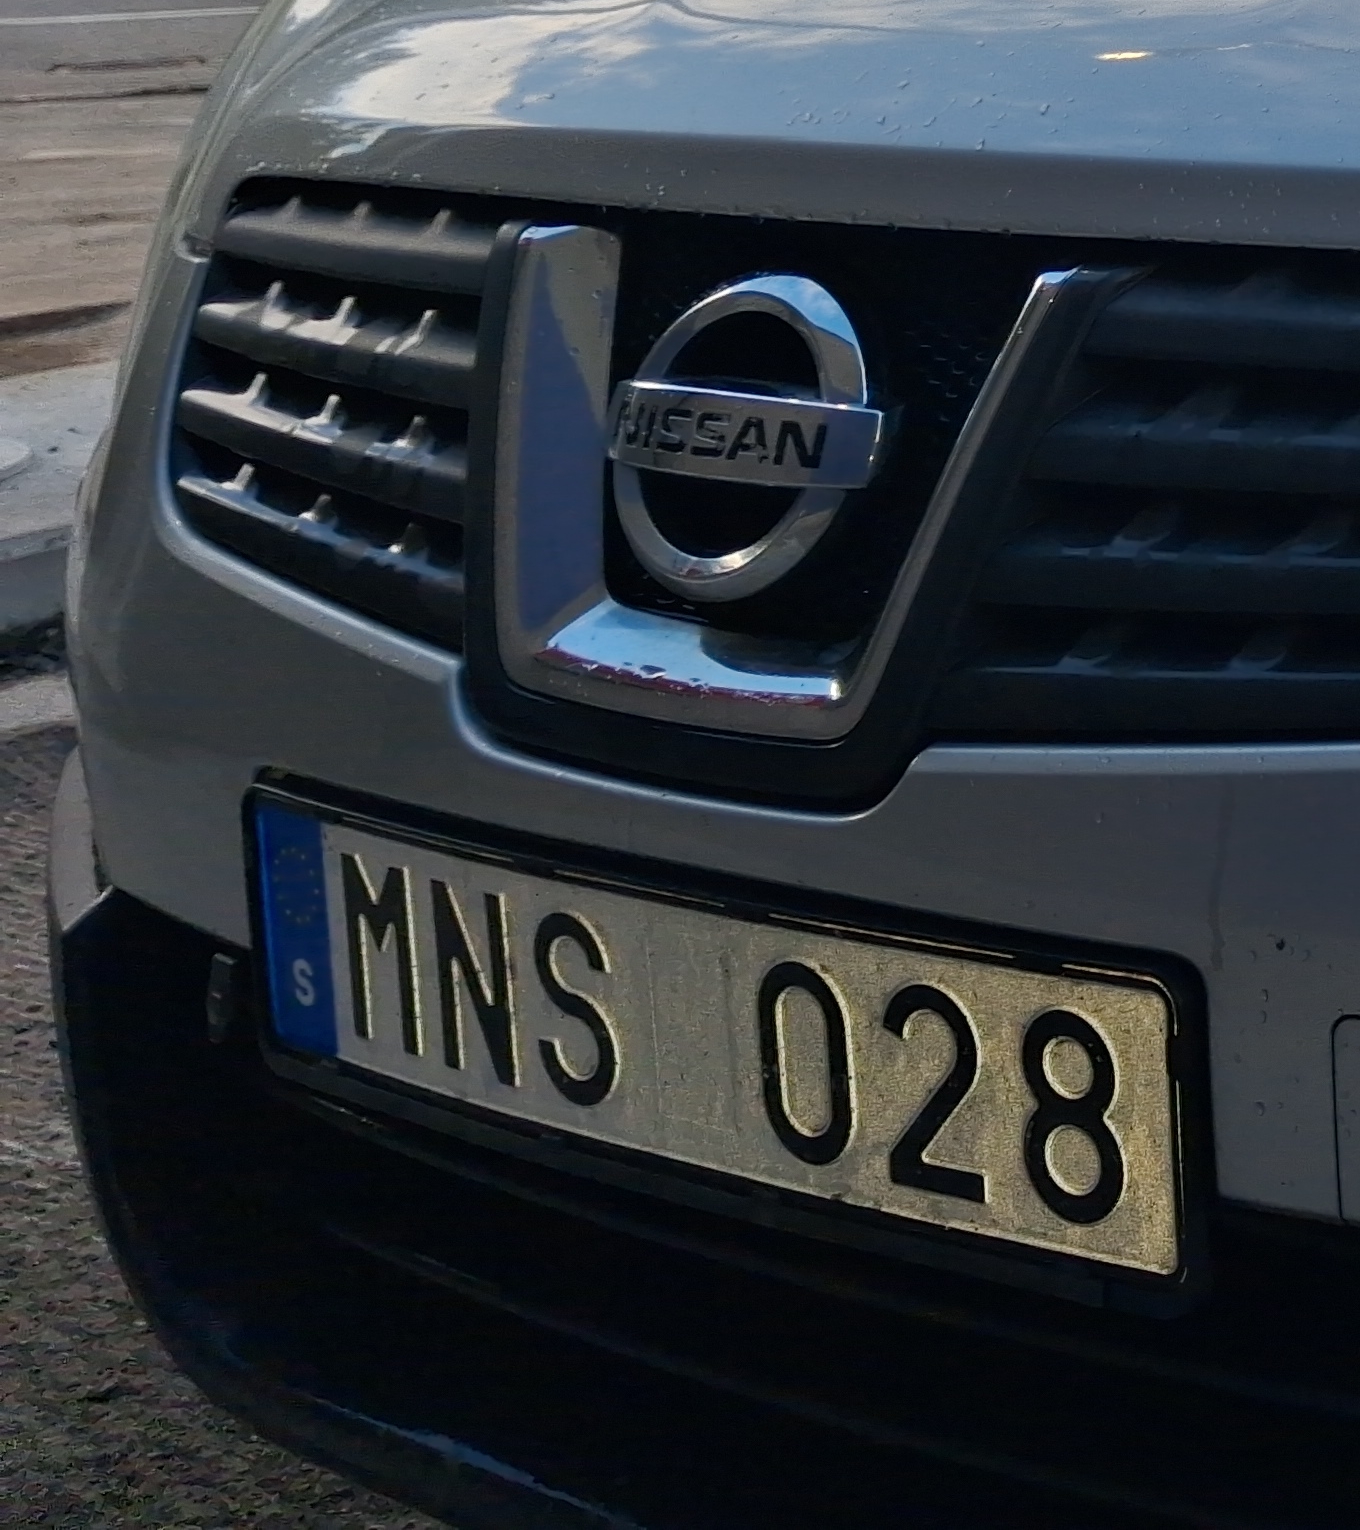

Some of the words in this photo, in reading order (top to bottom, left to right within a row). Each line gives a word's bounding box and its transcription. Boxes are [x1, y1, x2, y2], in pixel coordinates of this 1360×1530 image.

[614, 399, 828, 469] NISSAN
[293, 958, 315, 1006] S
[341, 852, 621, 1106] MNS
[757, 961, 1127, 1225] 028
